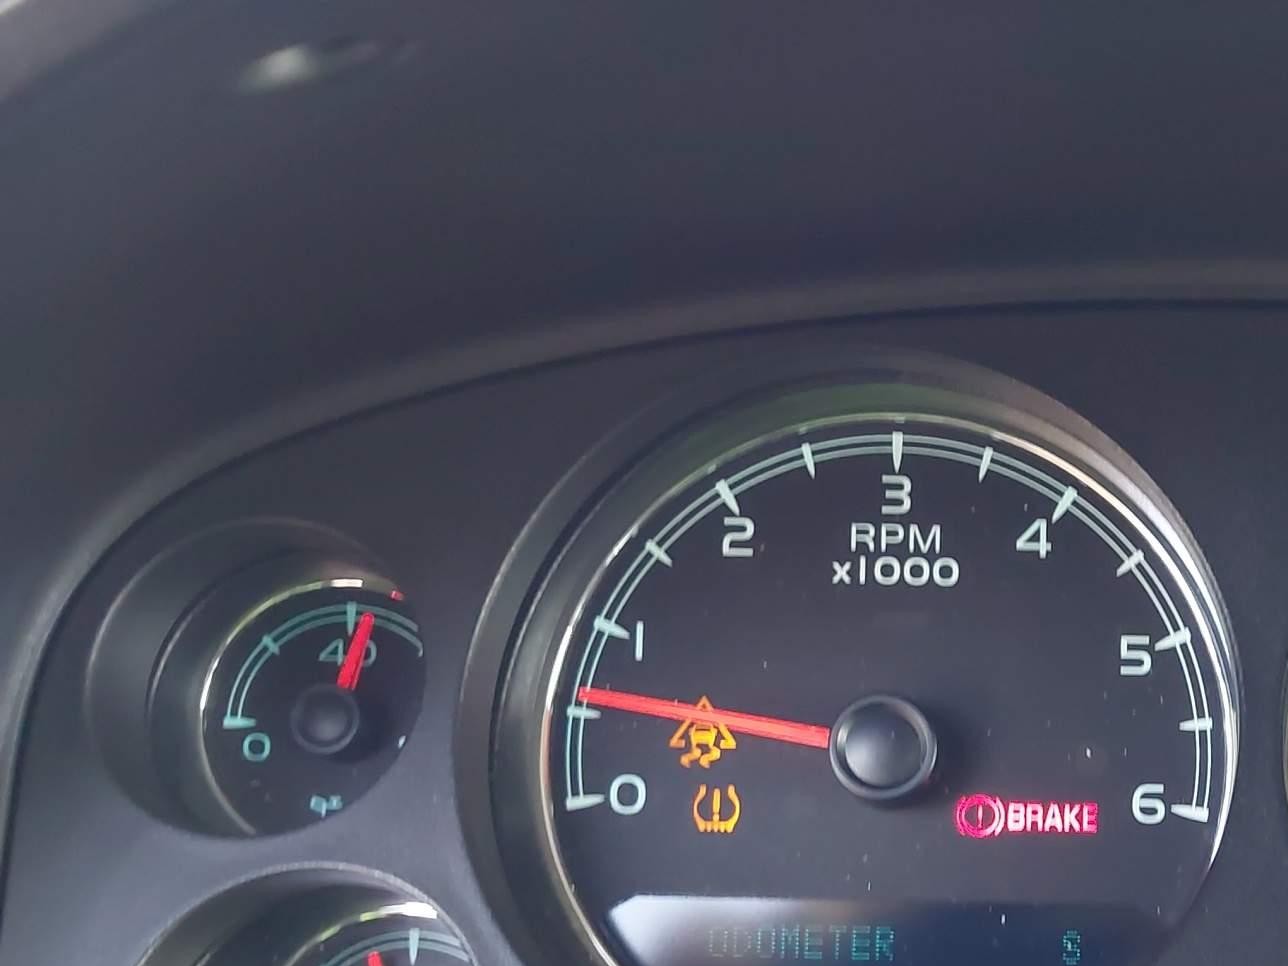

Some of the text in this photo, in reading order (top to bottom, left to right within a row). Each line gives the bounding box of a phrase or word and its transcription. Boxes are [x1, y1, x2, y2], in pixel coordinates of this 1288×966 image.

[881, 475, 912, 514] 3
[721, 517, 754, 557] 2
[850, 524, 942, 554] RPM
[1014, 518, 1052, 558] 4
[831, 557, 960, 587] x1000
[635, 621, 645, 660] 1
[1119, 635, 1152, 675] 5
[242, 733, 270, 761] 0
[609, 775, 646, 816] 0
[1131, 783, 1165, 825] 6
[1007, 802, 1098, 833] BRAKE
[707, 925, 895, 961] ODOMETER
